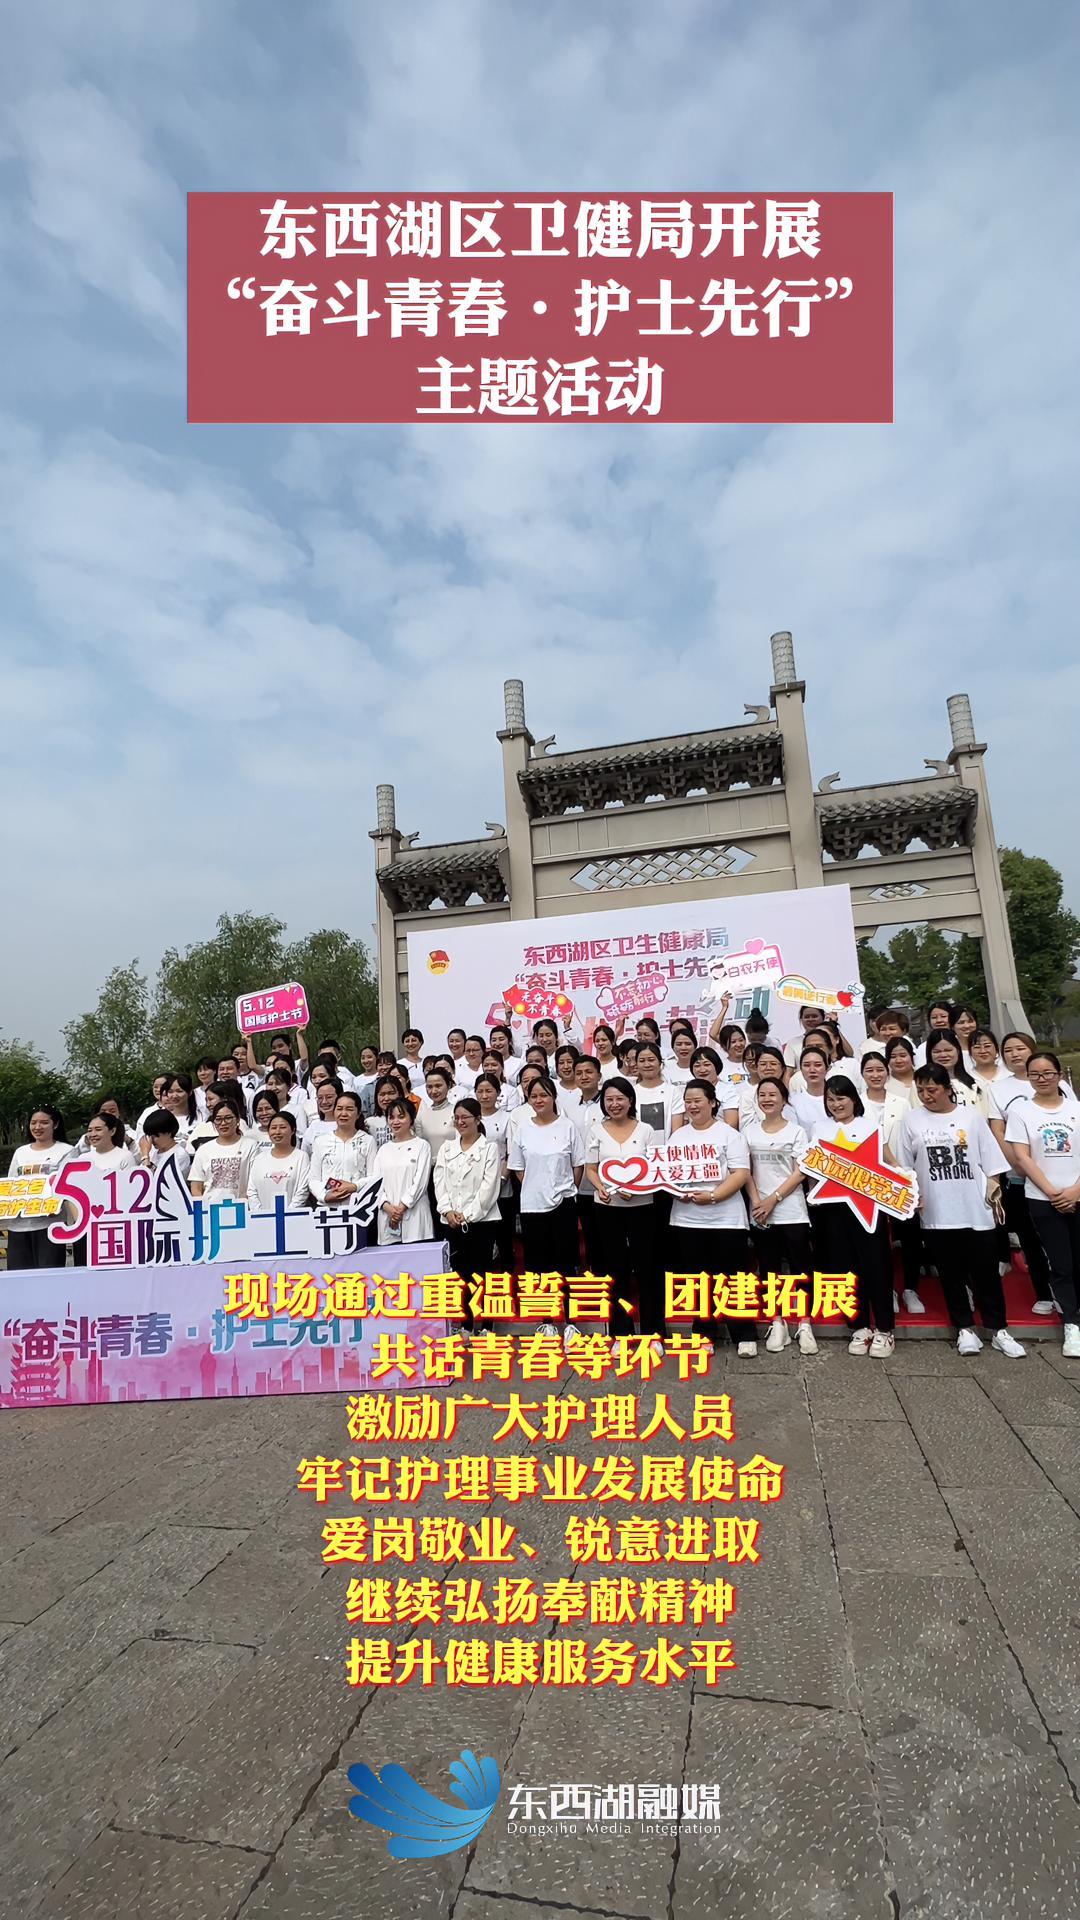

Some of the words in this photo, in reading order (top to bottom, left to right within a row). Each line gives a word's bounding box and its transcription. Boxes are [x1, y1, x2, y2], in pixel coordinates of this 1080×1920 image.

[523, 927, 729, 967] 东西湖区卫生健康局
[727, 956, 780, 979] 白衣天使
[614, 976, 660, 1001] 不忘初心
[242, 996, 275, 1012] 5.12
[527, 1003, 563, 1018] 不青春
[605, 992, 655, 1017] 砥砺前行
[244, 1007, 303, 1028] 国际护士节
[649, 1143, 717, 1163] 天使情怀
[926, 1145, 968, 1167] BE
[650, 1162, 720, 1182] 大爱无疆
[802, 1146, 915, 1215] 永远跟党走
[928, 1163, 975, 1181] STRONG
[90, 1195, 365, 1268] 国际护士节
